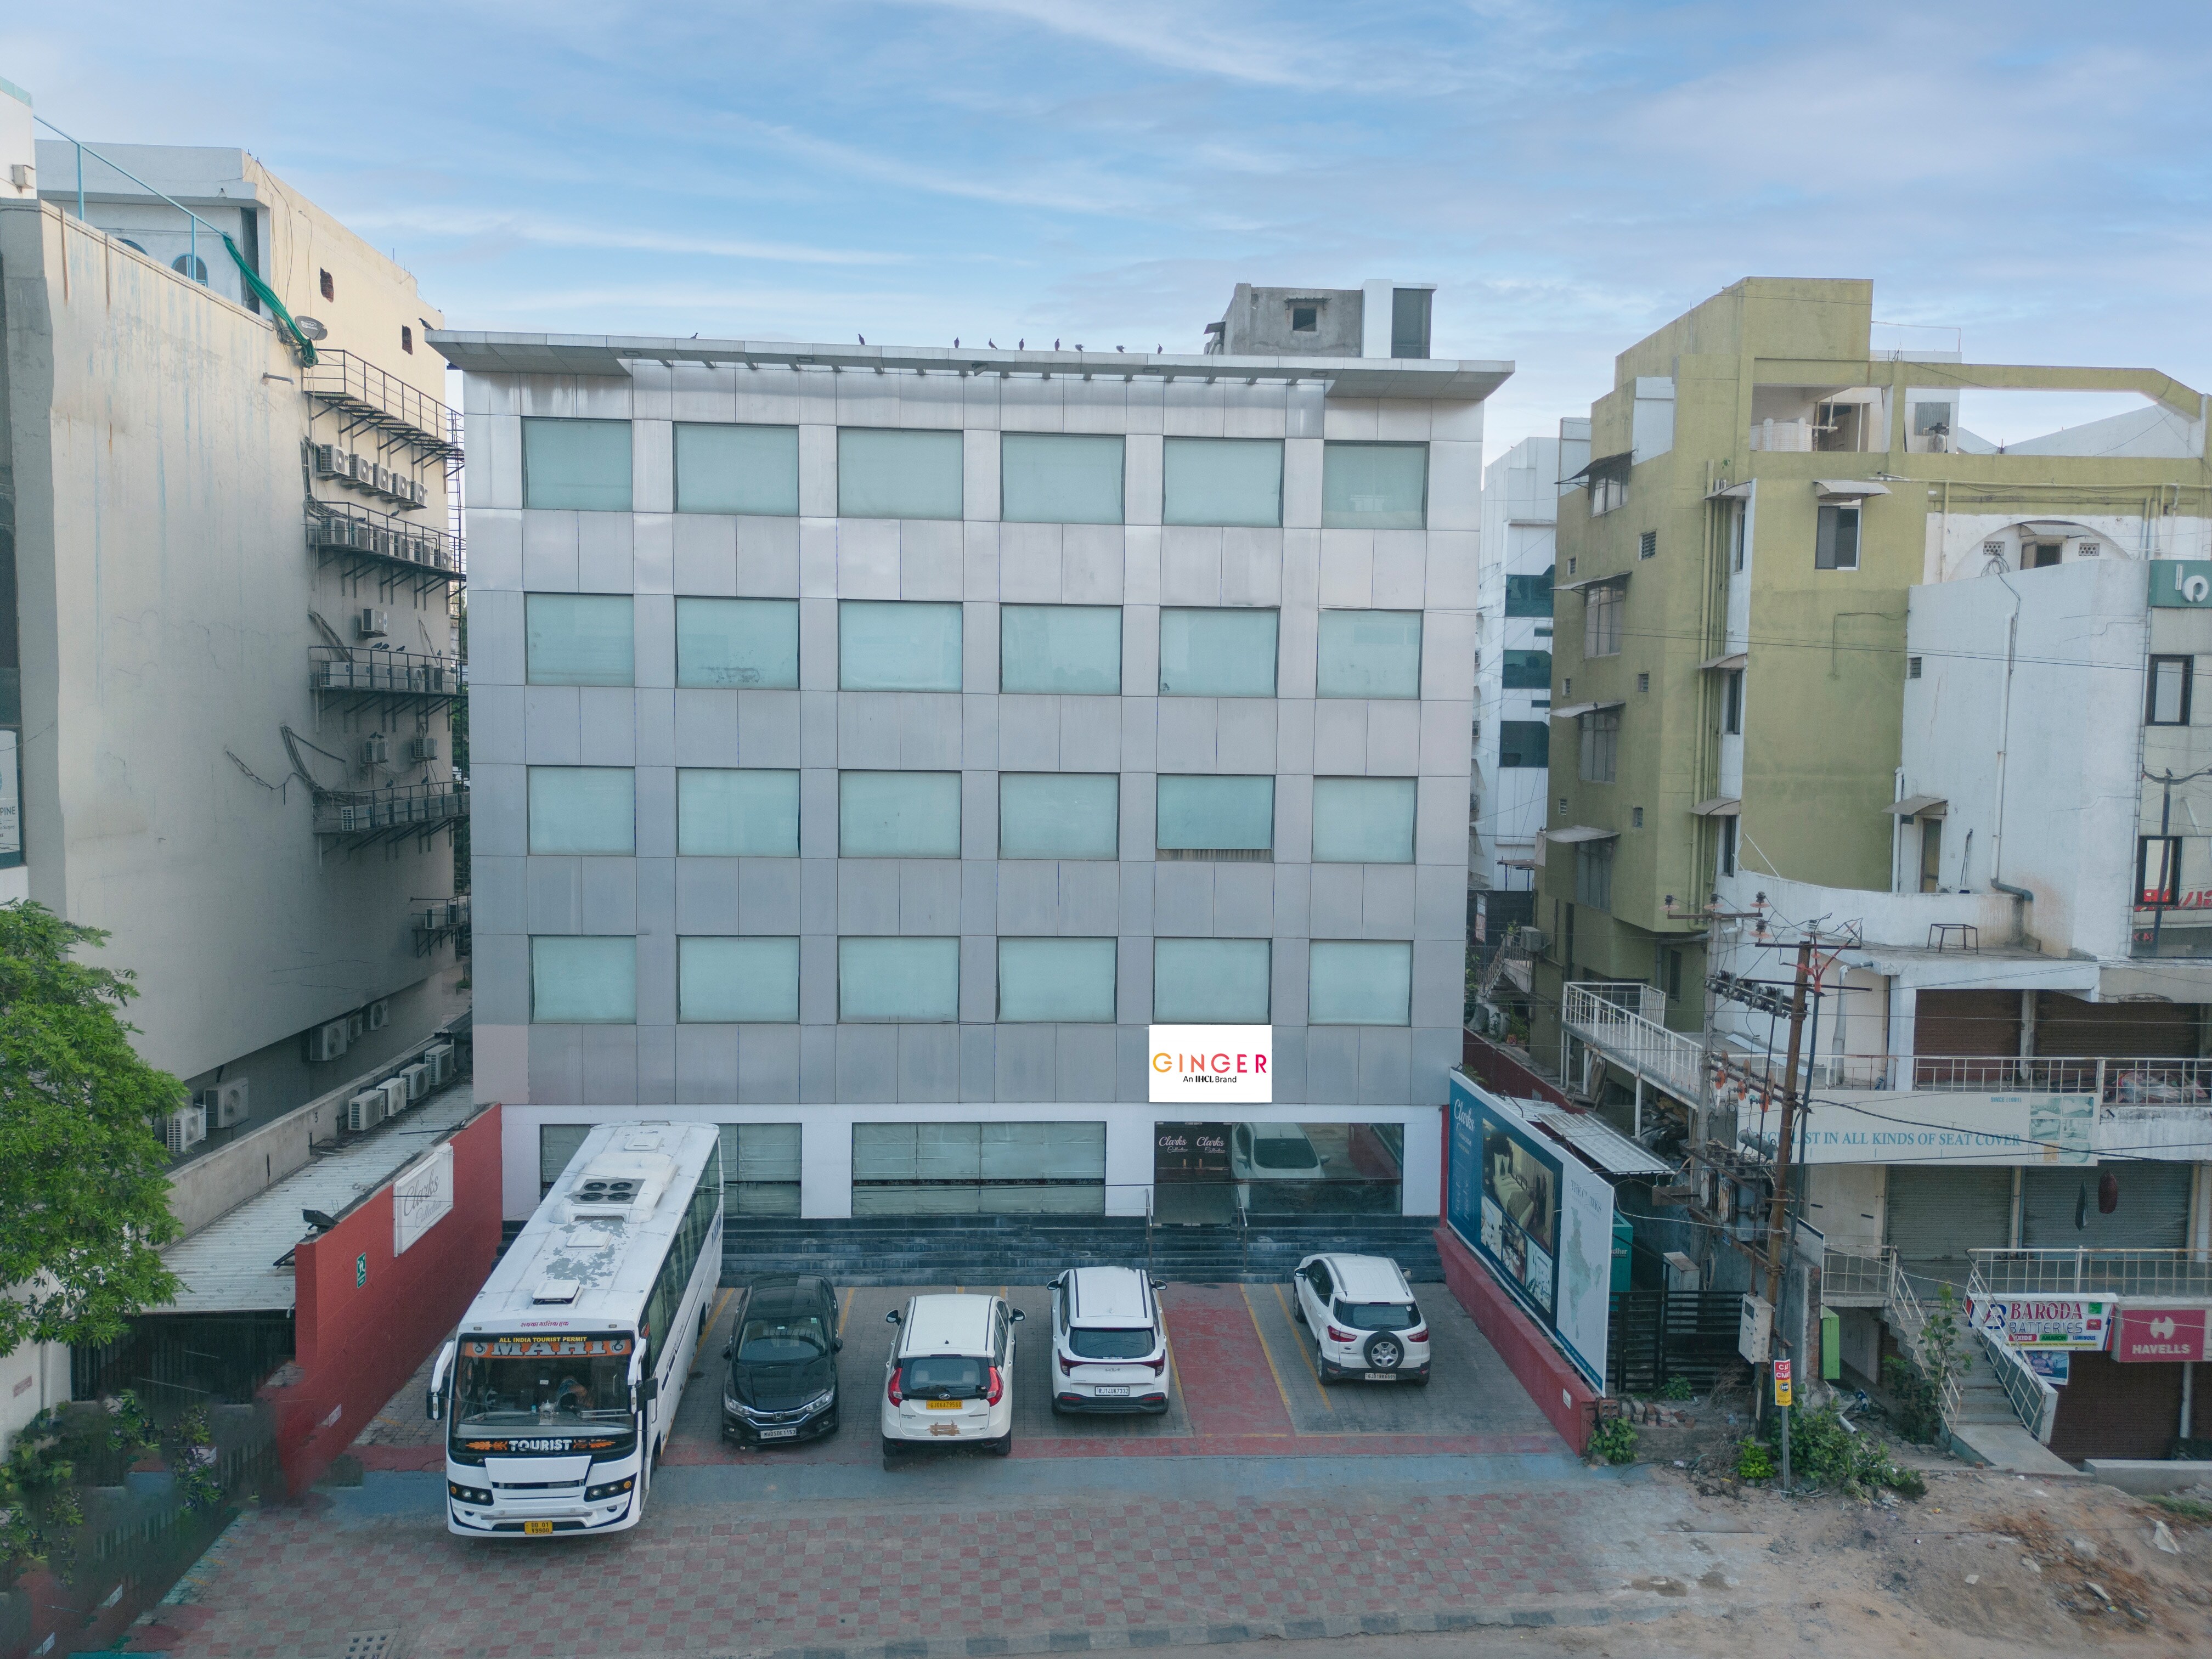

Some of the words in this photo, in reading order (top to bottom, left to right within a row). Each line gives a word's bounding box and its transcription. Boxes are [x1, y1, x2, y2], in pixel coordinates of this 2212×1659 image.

[1153, 1053, 1267, 1074] GINGER
[1454, 1099, 1475, 1132] Clarks
[1159, 1136, 1187, 1147] Clarks
[1197, 1136, 1224, 1147] Clarks
[1824, 1132, 1840, 1144] IN
[1842, 1132, 1869, 1144] ALL
[1872, 1132, 1914, 1145] KINDS
[1918, 1133, 1936, 1145] OF
[1939, 1133, 1972, 1145] SEAT
[1976, 1134, 2021, 1146] COVER
[403, 1169, 439, 1217] Clarks
[2010, 1302, 2083, 1319] BARODA
[2010, 1322, 2083, 1334] BATTERIES
[492, 1341, 607, 1356] MAHI
[2132, 1344, 2191, 1355] HAVELLS
[509, 1440, 572, 1452] TOURIST
